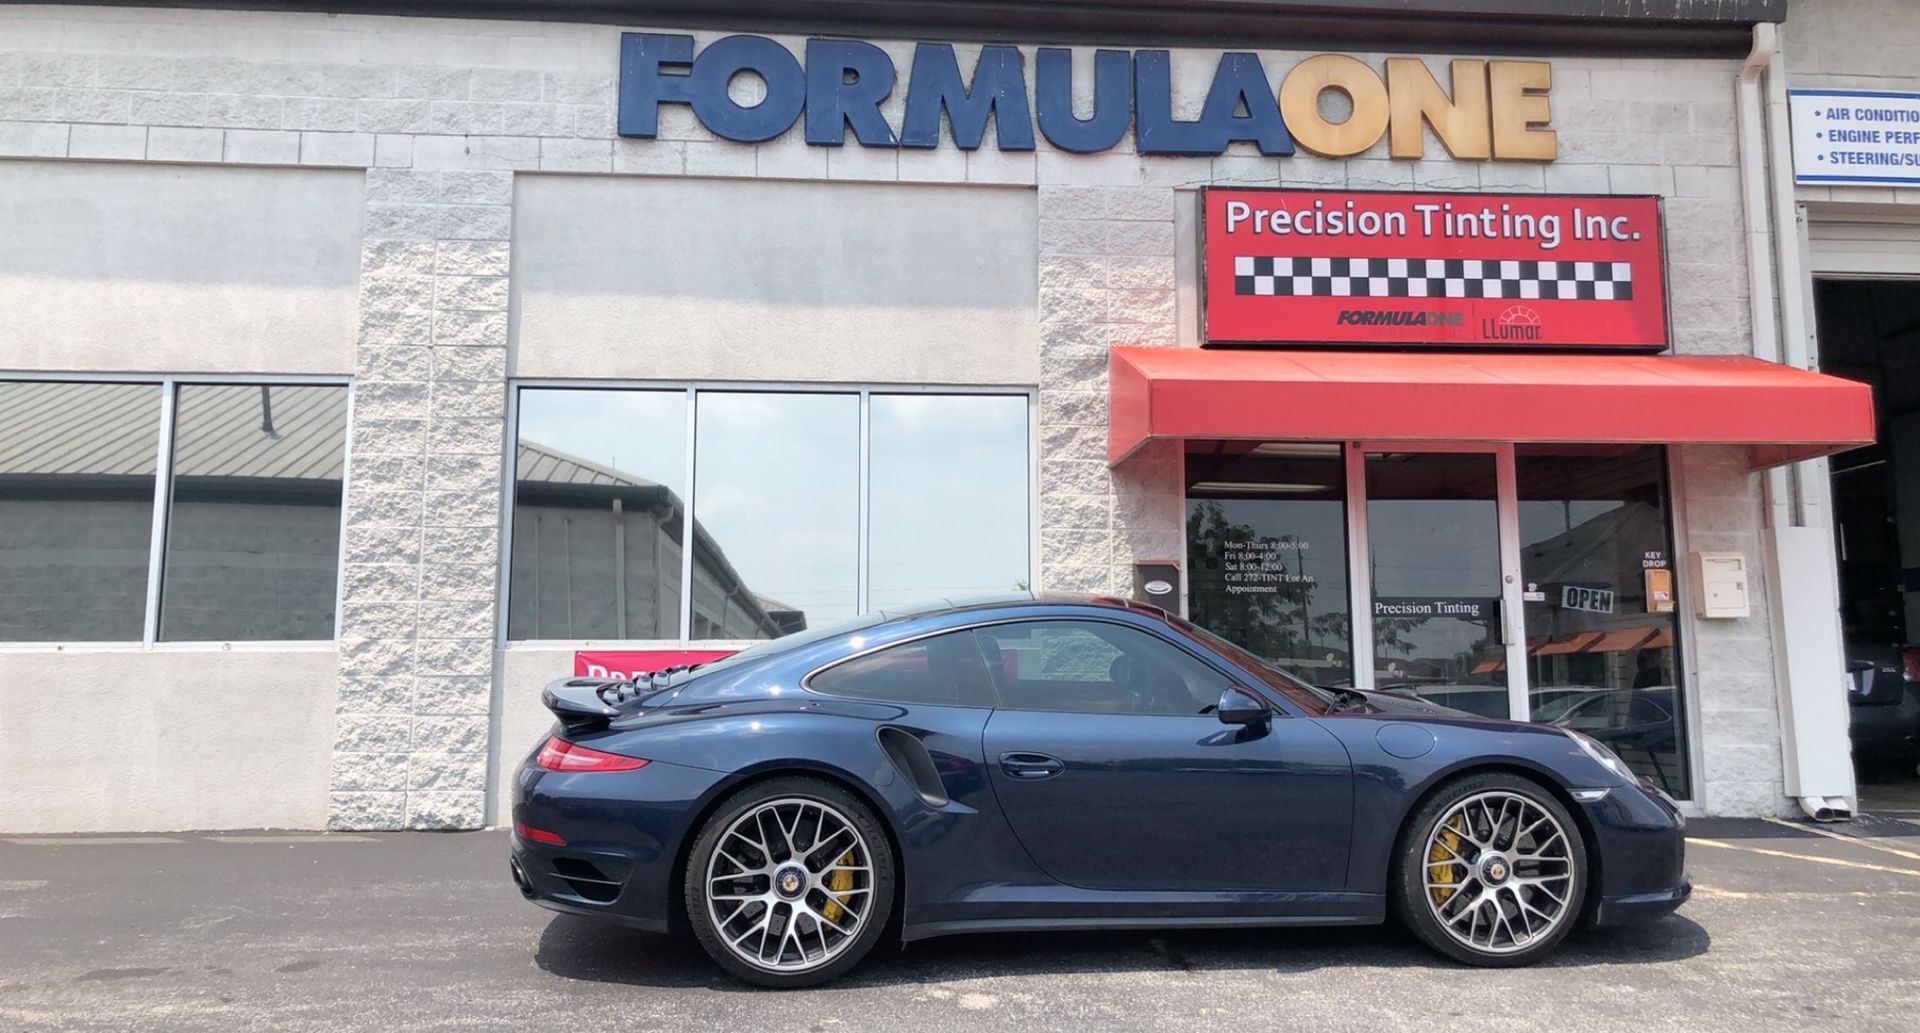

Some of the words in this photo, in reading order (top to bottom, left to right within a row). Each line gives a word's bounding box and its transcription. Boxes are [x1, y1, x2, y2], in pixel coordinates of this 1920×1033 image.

[1826, 108, 1850, 120] AIR
[1855, 109, 1920, 122] CONDITIO
[1828, 130, 1881, 143] ENGINE
[1885, 131, 1920, 144] PERF
[1226, 200, 1406, 236] Precision
[1413, 202, 1561, 249] Tinting
[1572, 207, 1641, 240] Inc.
[1224, 541, 1268, 549] Mon-Thurs
[1270, 542, 1309, 550] 8:00-5:00
[1224, 551, 1236, 560] Fri
[1238, 552, 1277, 560] 8:00-4:00
[1644, 551, 1662, 560] KEY
[1225, 562, 1238, 571] Sat
[1239, 563, 1283, 571] 8:00-12:00
[1642, 560, 1667, 568] DROP
[1224, 573, 1242, 582] Call
[1244, 573, 1283, 582] 272-TINT
[1225, 585, 1277, 595] Appointment
[1566, 587, 1613, 612] OPEN
[1375, 602, 1432, 614] Precision
[1434, 601, 1480, 617] Tinting
